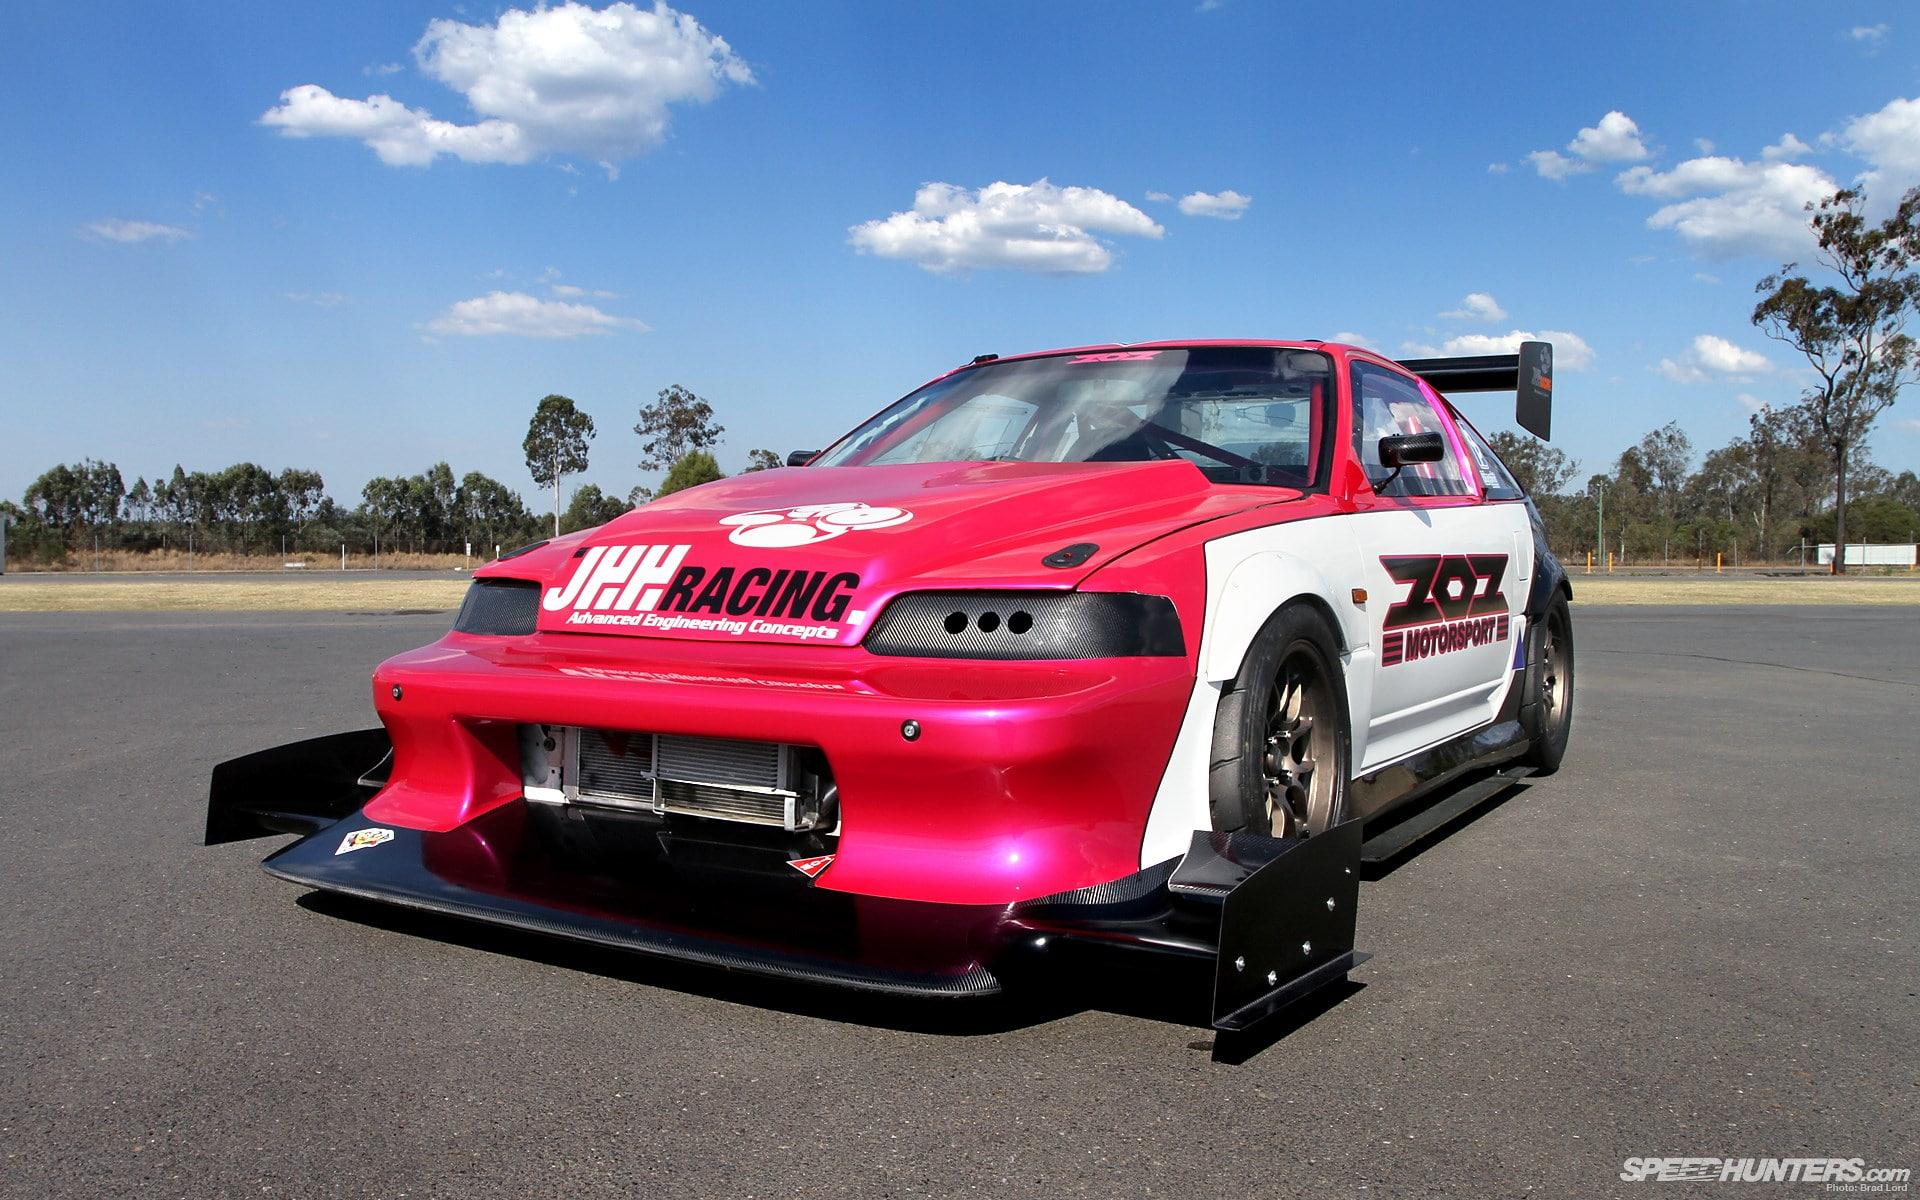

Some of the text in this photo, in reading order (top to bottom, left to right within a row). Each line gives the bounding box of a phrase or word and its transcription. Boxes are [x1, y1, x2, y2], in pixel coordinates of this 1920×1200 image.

[542, 544, 692, 611] JHH
[566, 611, 839, 640] Advanced Engineering Concepts
[1404, 616, 1497, 662] MOTORSPORT
